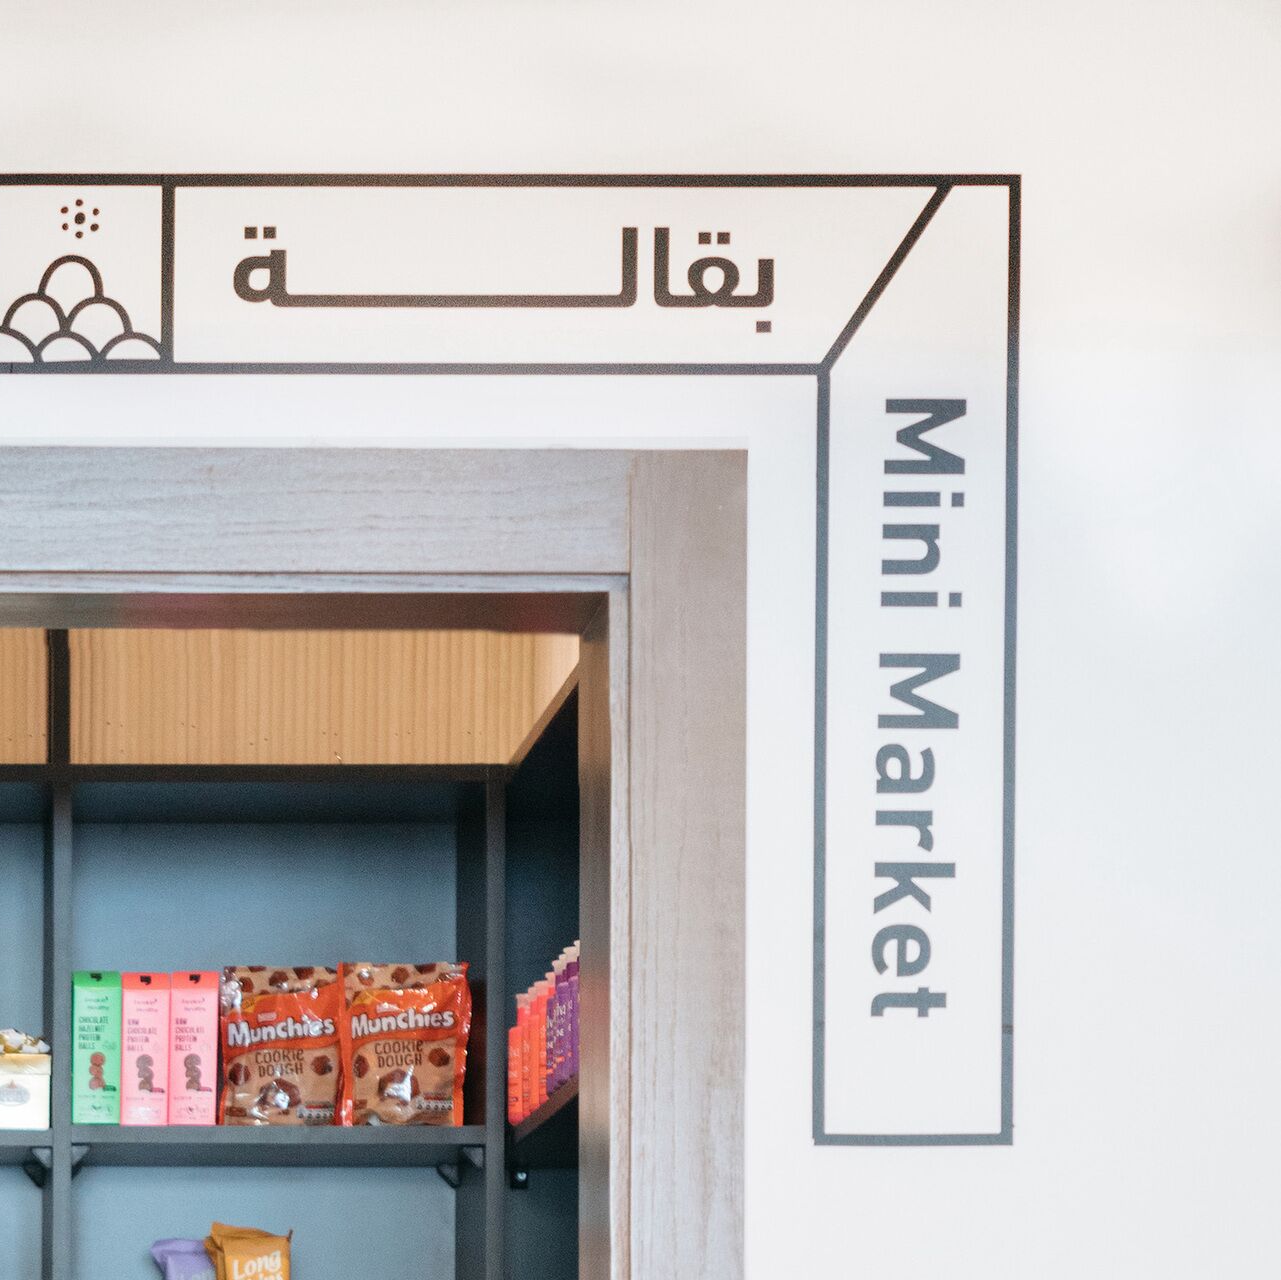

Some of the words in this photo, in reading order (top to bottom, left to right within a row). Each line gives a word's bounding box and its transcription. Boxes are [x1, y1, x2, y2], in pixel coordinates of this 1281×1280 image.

[881, 399, 966, 607] Mini
[871, 654, 960, 1017] Market
[227, 1016, 336, 1047] Munchies
[351, 1007, 455, 1039] Munchies
[255, 1048, 304, 1064] COOKIE
[374, 1040, 424, 1055] COOKIE
[378, 1053, 422, 1068] DOUGH
[258, 1062, 304, 1078] DOUGH
[233, 1250, 281, 1280] Long
